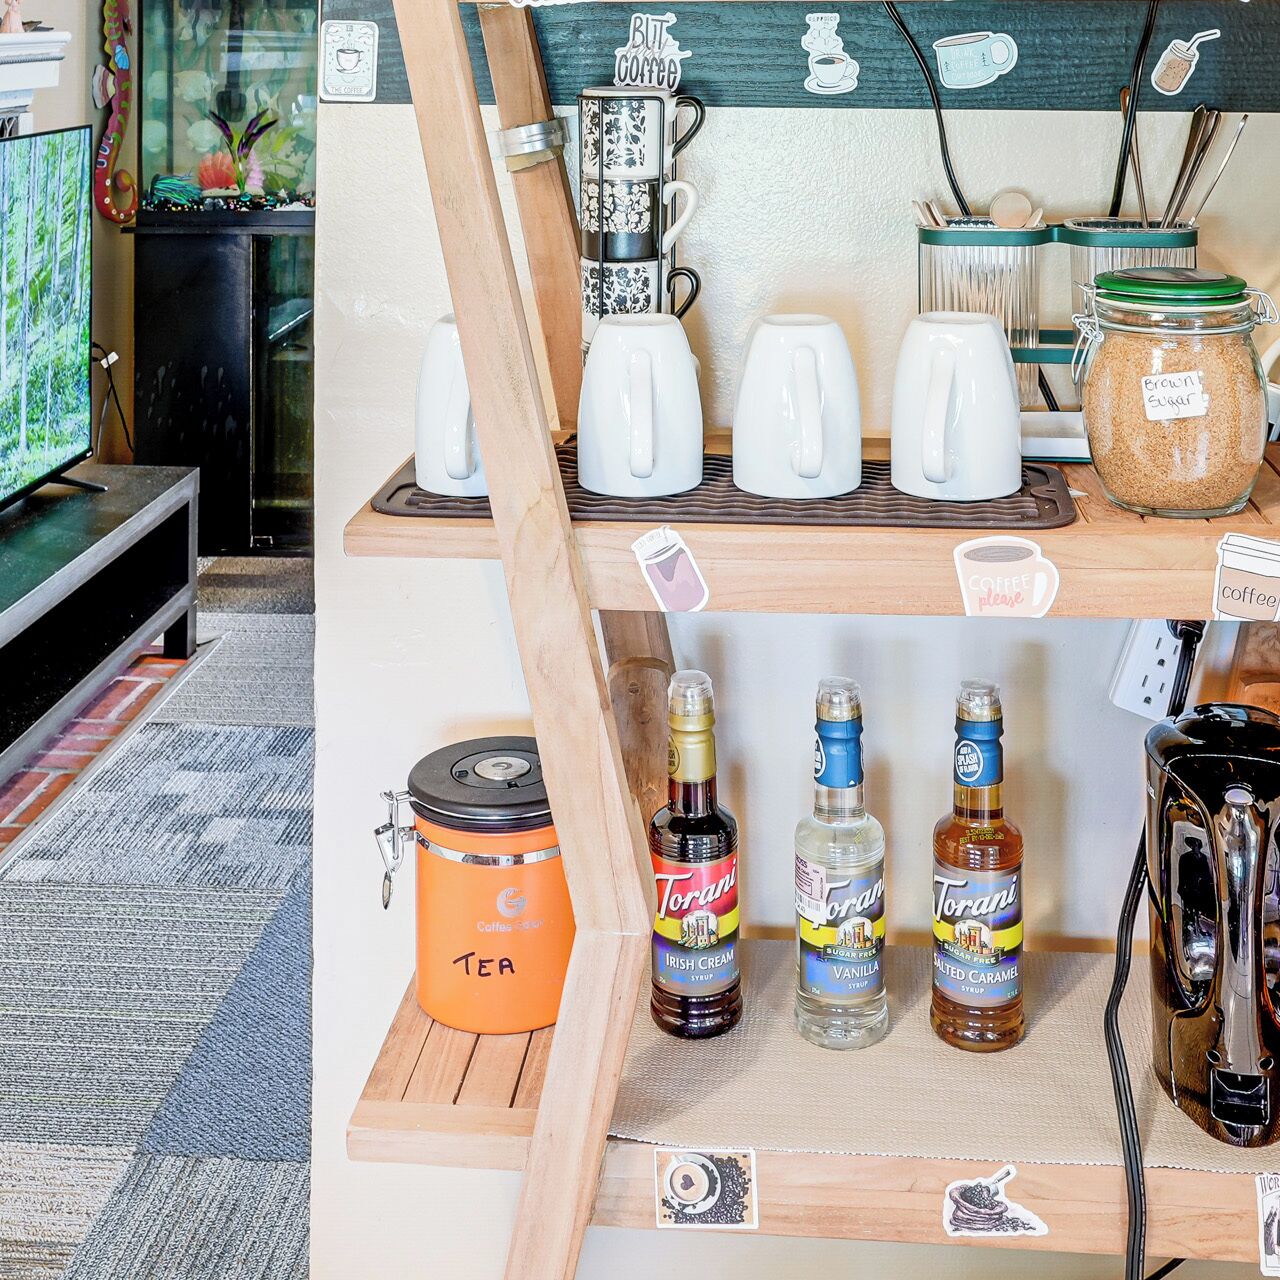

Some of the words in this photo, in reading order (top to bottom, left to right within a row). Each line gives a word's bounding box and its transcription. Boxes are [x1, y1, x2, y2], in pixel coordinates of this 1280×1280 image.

[632, 16, 670, 51] BUT
[617, 54, 678, 90] coffee
[344, 87, 364, 95] COFFEE
[1144, 375, 1195, 391] Brown
[969, 573, 1030, 593] COFFEE
[978, 587, 1025, 612] please
[1222, 585, 1277, 608] coffee
[957, 753, 978, 766] SPLASH
[655, 858, 737, 921] Torani
[934, 874, 1018, 923] Torani
[476, 920, 513, 932] Coffee
[665, 952, 695, 971] IRISH
[698, 949, 734, 971] CREAM
[826, 947, 856, 959] SUGAR
[858, 948, 877, 959] FREE
[943, 943, 972, 961] SUGAR
[973, 954, 997, 965] FREE
[452, 951, 515, 977] TEA
[833, 960, 879, 979] VANILLA
[933, 953, 967, 981] SALTED
[968, 965, 1019, 984] CARAMEL
[691, 973, 714, 982] SYRUP
[848, 980, 869, 990] SYRUP
[961, 985, 985, 994] SYRUP
